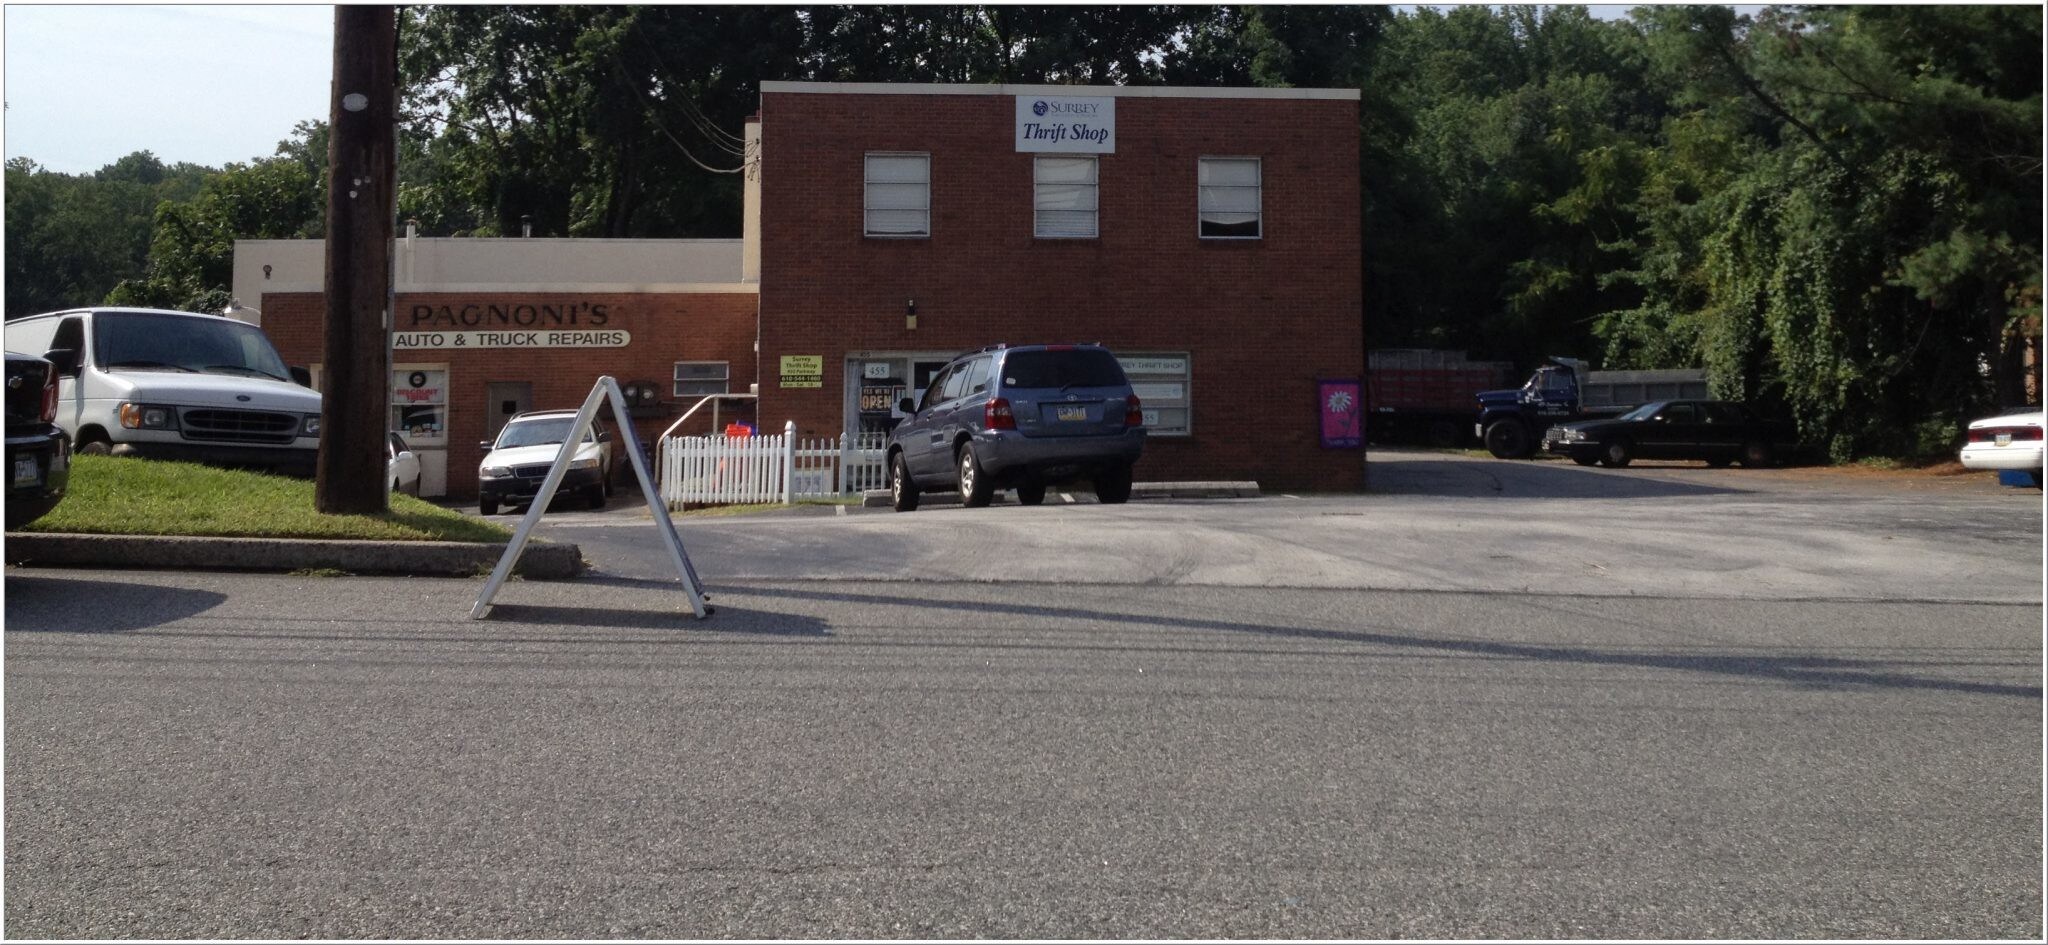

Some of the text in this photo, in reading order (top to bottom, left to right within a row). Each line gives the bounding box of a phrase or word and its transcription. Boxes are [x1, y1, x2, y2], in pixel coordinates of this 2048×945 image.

[1023, 123, 1109, 144] Thrift Shop
[411, 302, 609, 326] PAGNONI'S
[395, 332, 624, 347] AUTO & TRUCK REPAIRS
[869, 366, 886, 376] 455
[862, 395, 891, 409] OPEN
